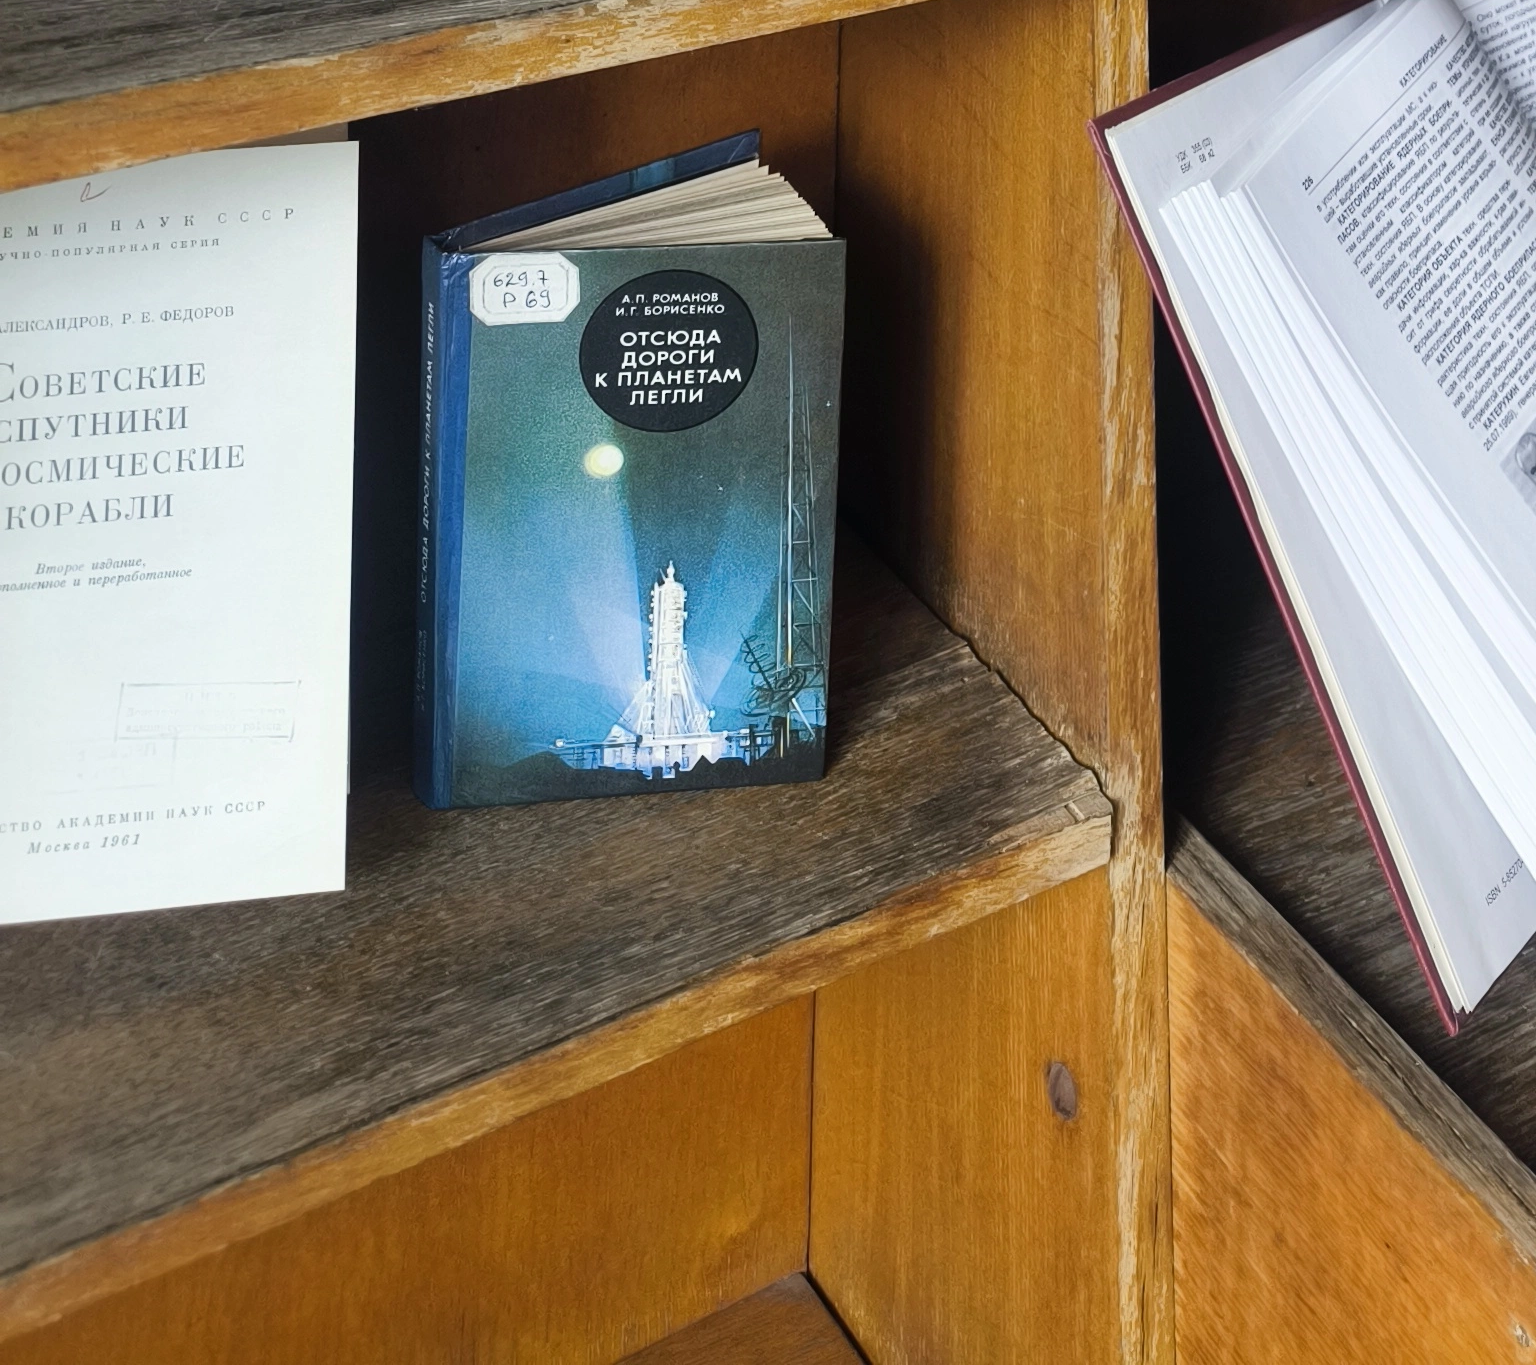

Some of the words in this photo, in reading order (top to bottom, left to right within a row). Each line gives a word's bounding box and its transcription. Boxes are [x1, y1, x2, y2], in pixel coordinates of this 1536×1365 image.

[1302, 175, 1313, 190] 226
[1336, 159, 1395, 225] КАТЕГОРИРОВАНИЕ
[1396, 125, 1427, 160] ЯДЕРНЫХ
[110, 214, 195, 232] НАУК
[217, 208, 295, 225] СССР
[170, 238, 220, 250] СЕРИЯ
[493, 269, 549, 288] 629.7
[1396, 268, 1432, 311] КАТЕГОРИЯ
[1431, 235, 1462, 270] ОБЪЕКТА
[525, 290, 551, 308] 69
[622, 294, 648, 304] А.П.
[652, 292, 719, 304] РОМАНОВ
[121, 313, 136, 325] Р.
[141, 311, 155, 324] Е.
[160, 305, 235, 324] ФЕДОРОВ
[644, 303, 725, 316] БОРИСЕНКО
[1435, 320, 1472, 365] КАТЕГОРИЯ
[1470, 281, 1505, 323] ЯДЕРНОГО
[620, 329, 721, 348] ОТСЮДА
[621, 349, 715, 369] ДОРОГИ
[595, 373, 608, 387] К
[617, 368, 742, 387] ПЛАНЕТАМ
[426, 360, 434, 445] ПЛАНЕТАМ
[629, 389, 703, 406] ЛЕГЛИ
[1479, 383, 1519, 430] КАТЕРУХИН
[1, 444, 245, 487] ОСМИЧЕСКИЕ
[423, 464, 432, 530] ДОРОГИ
[4, 493, 175, 531] КОРАБЛИ
[35, 562, 85, 577] Второе
[91, 557, 146, 572] издание,
[421, 536, 430, 603] ОТСЮДА
[73, 578, 81, 587] и
[87, 568, 193, 588] переработанное
[57, 811, 155, 831] АКАДЕМИИ
[166, 804, 213, 820] НАУК
[224, 800, 266, 815] СССР
[27, 840, 91, 855] Москва
[100, 833, 141, 849] 1961
